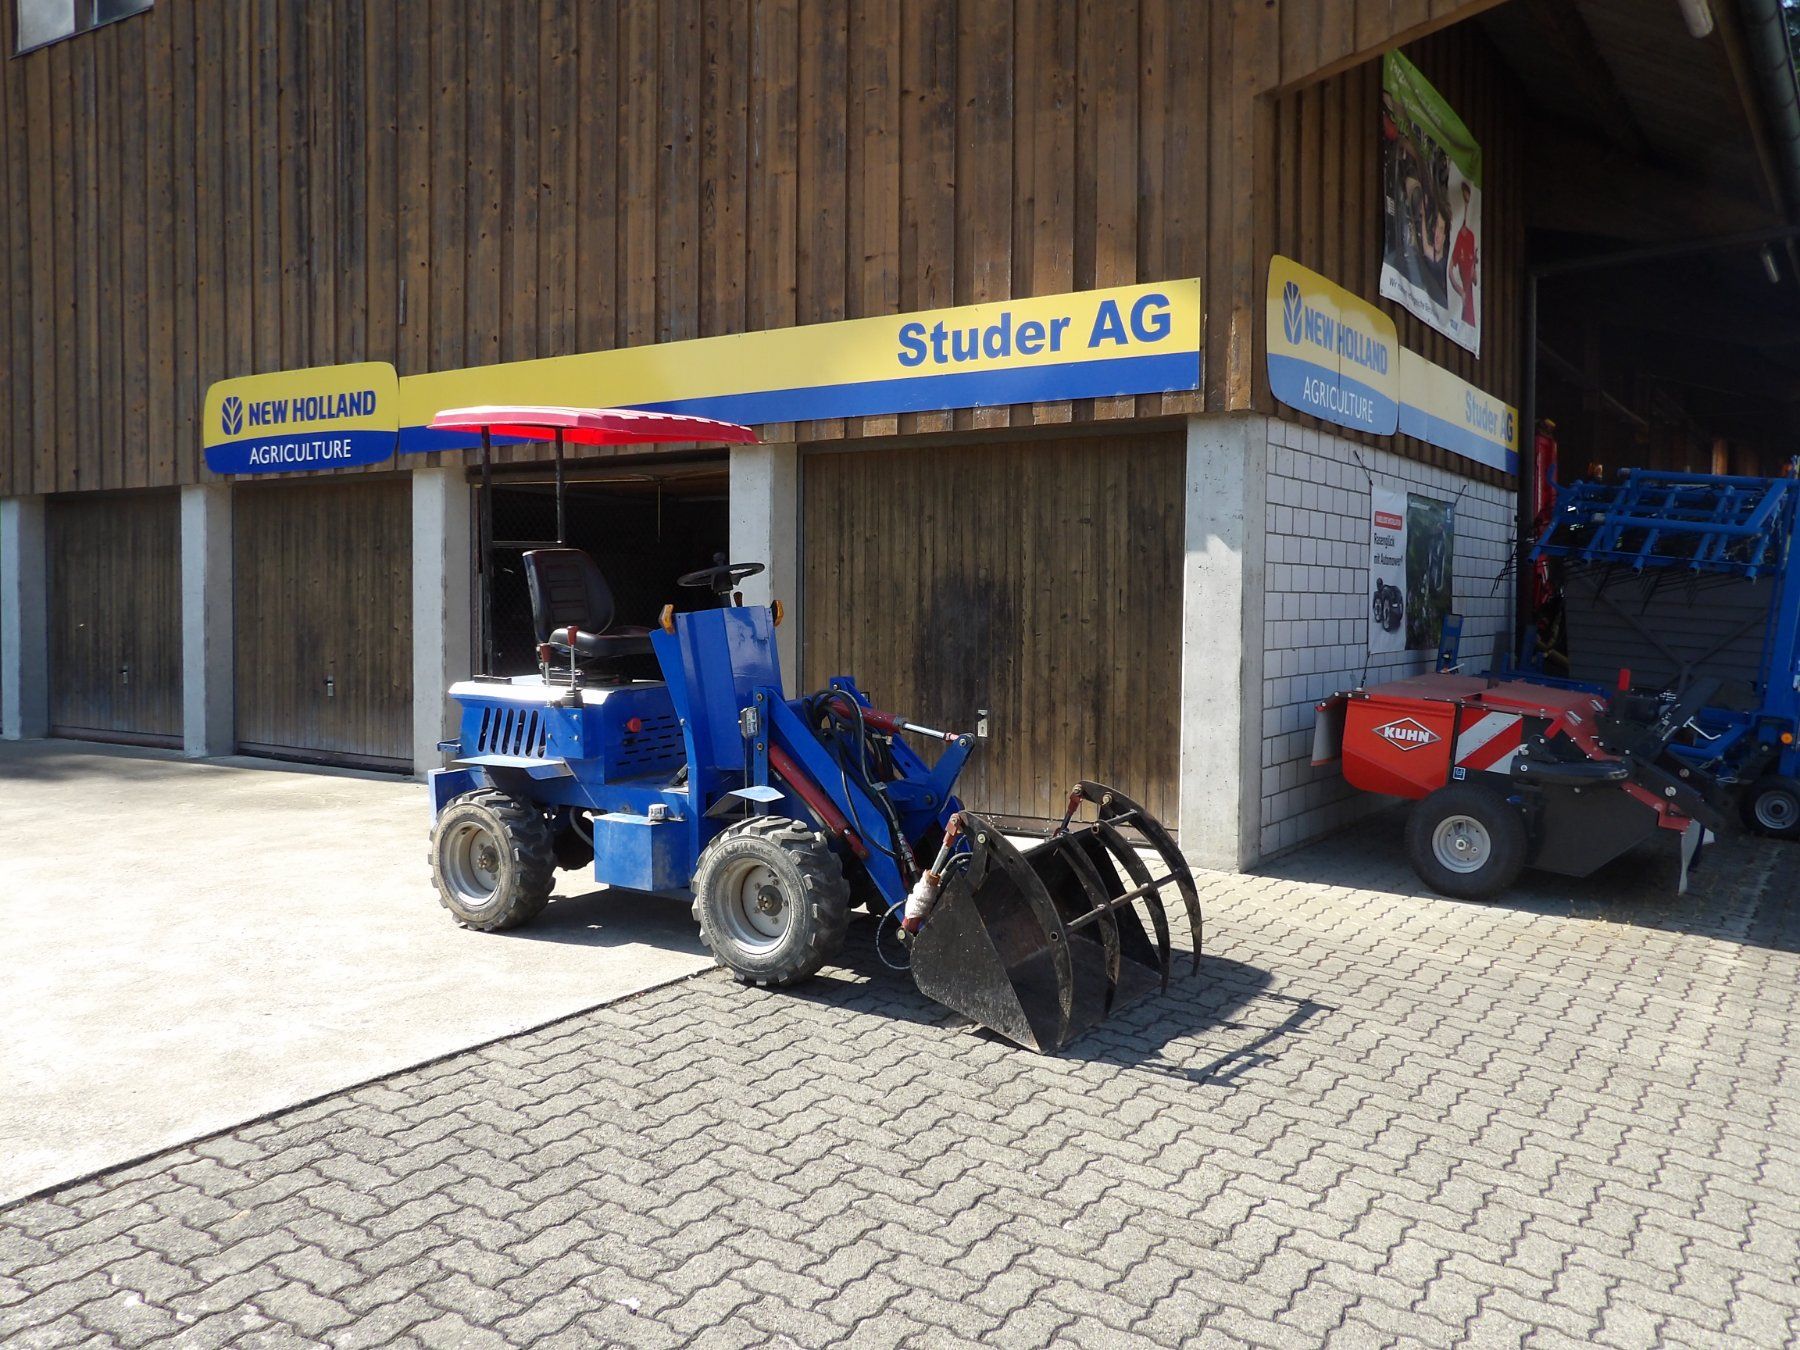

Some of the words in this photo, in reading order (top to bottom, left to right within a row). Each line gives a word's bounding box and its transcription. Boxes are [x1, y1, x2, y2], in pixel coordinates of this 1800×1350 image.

[897, 312, 1071, 368] Studer
[1088, 293, 1171, 349] AG
[1304, 306, 1334, 351] NEW
[1338, 322, 1388, 376] HOLLAND
[248, 400, 289, 427] NEW
[292, 390, 376, 423] HOLLAND
[1303, 376, 1374, 424] AGRICULTURE
[1465, 389, 1498, 436] Studer
[1500, 409, 1514, 443] AG
[249, 439, 352, 465] AGRICULTURE
[1384, 726, 1430, 744] KUHN
